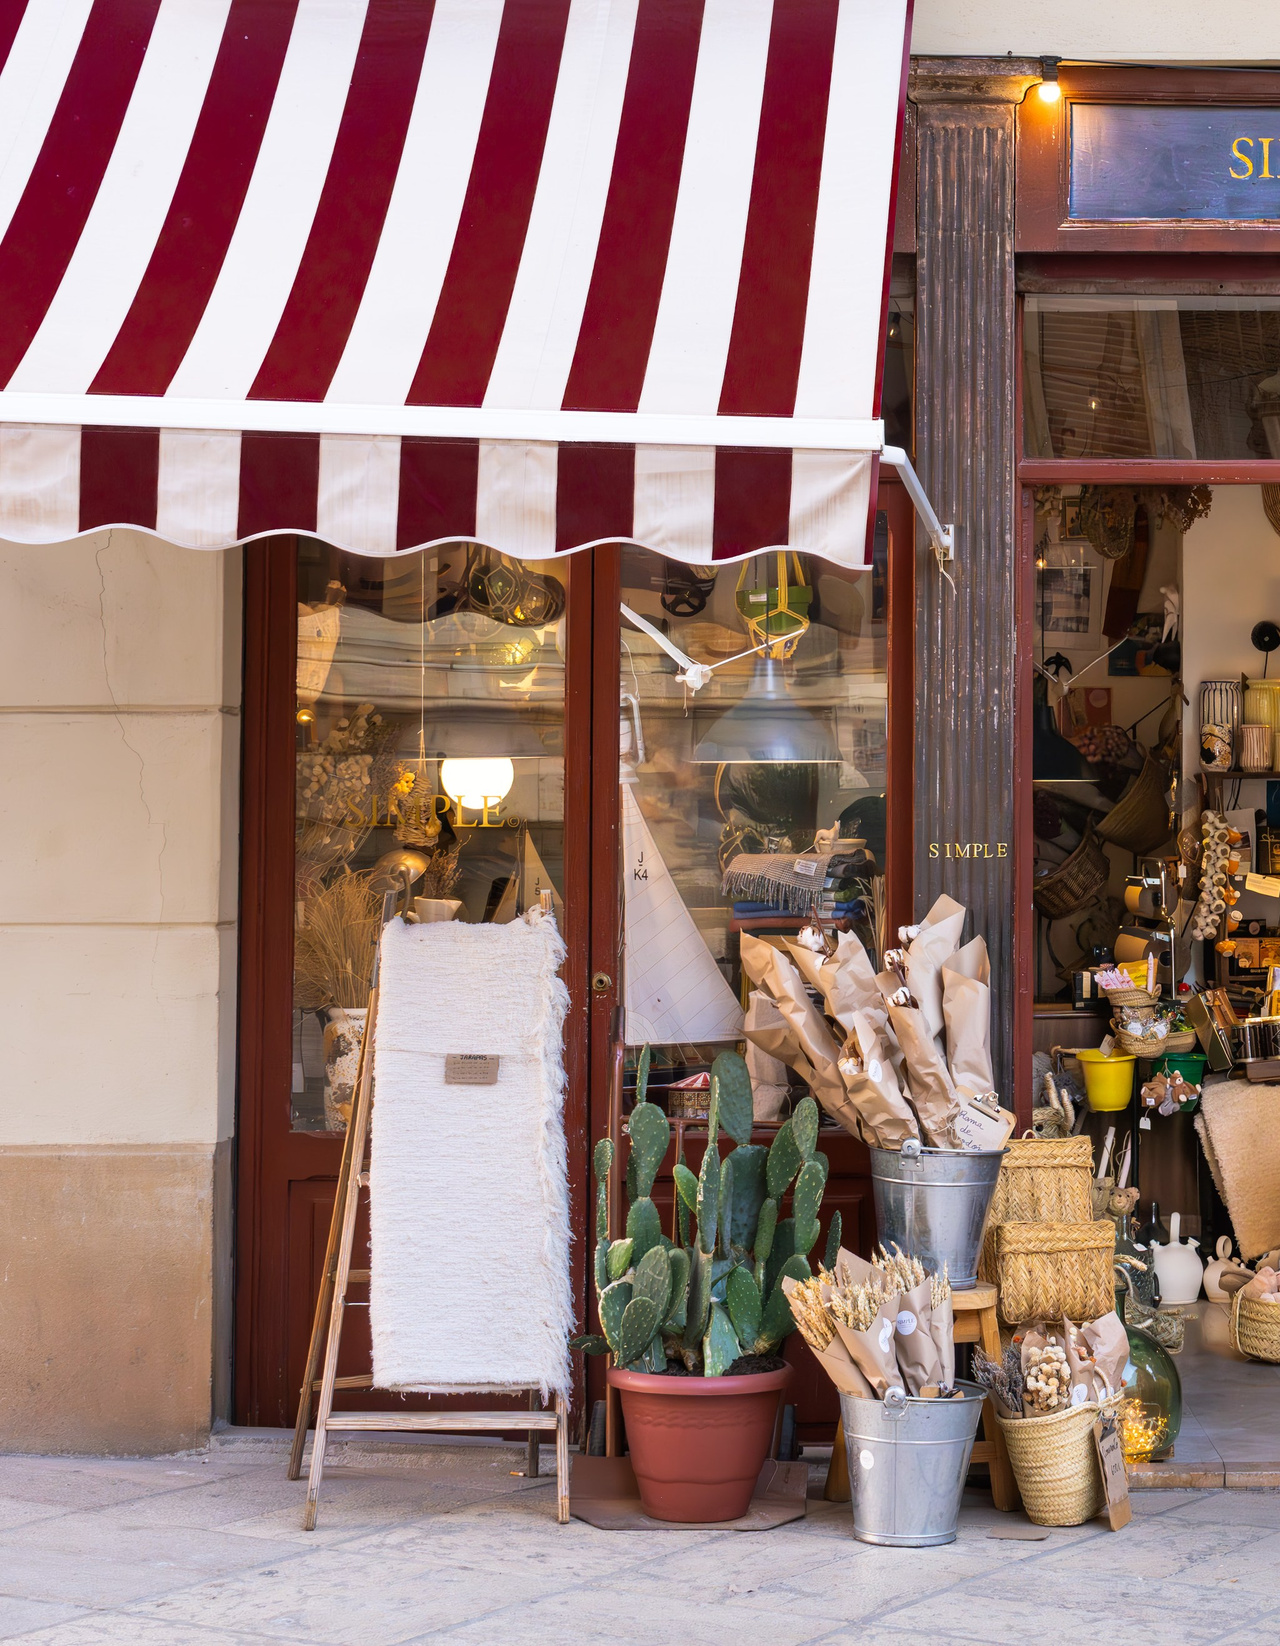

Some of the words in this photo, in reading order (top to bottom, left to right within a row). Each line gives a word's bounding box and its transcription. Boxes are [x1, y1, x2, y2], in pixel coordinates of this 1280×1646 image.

[928, 842, 1008, 859] SIMPLE
[633, 868, 649, 881] K4
[959, 1124, 974, 1137] de
